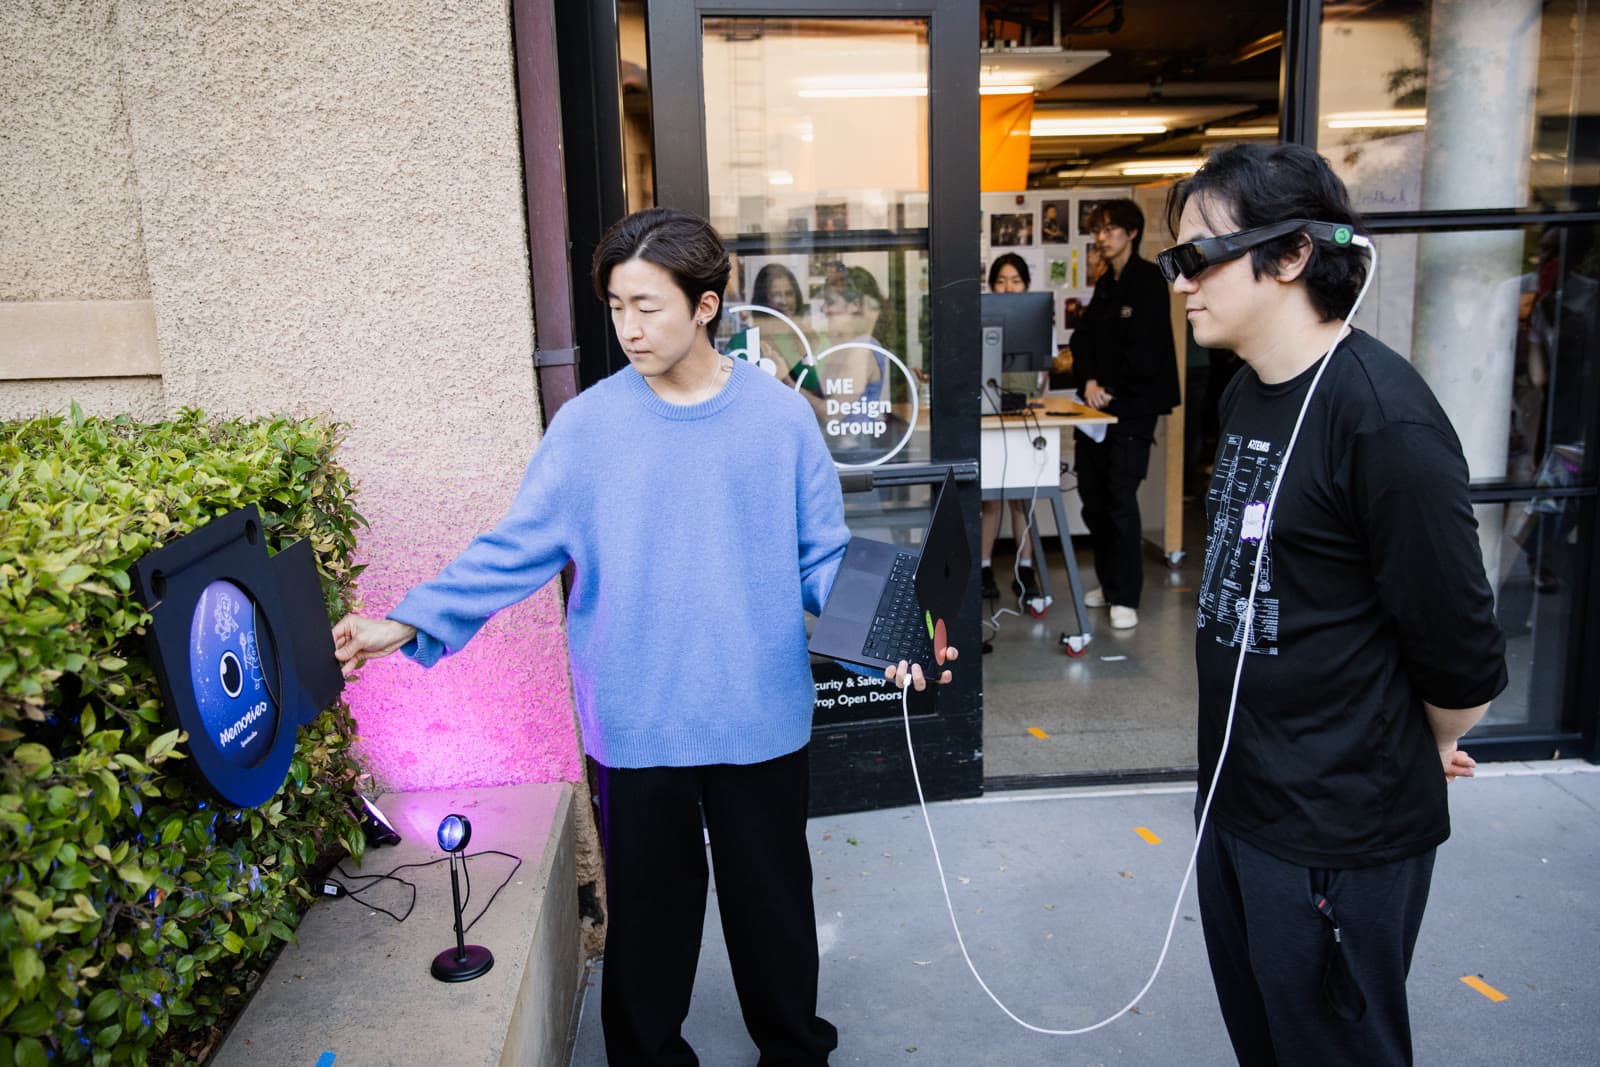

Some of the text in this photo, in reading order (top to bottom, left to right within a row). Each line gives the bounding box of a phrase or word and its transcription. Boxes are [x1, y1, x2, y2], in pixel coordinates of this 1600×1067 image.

[826, 378, 854, 395] ME
[826, 396, 892, 418] Design
[826, 419, 887, 438] Group
[815, 676, 886, 691] curity & Safety
[838, 694, 867, 707] Open
[869, 691, 903, 703] Doors
[220, 701, 267, 748] Memories
